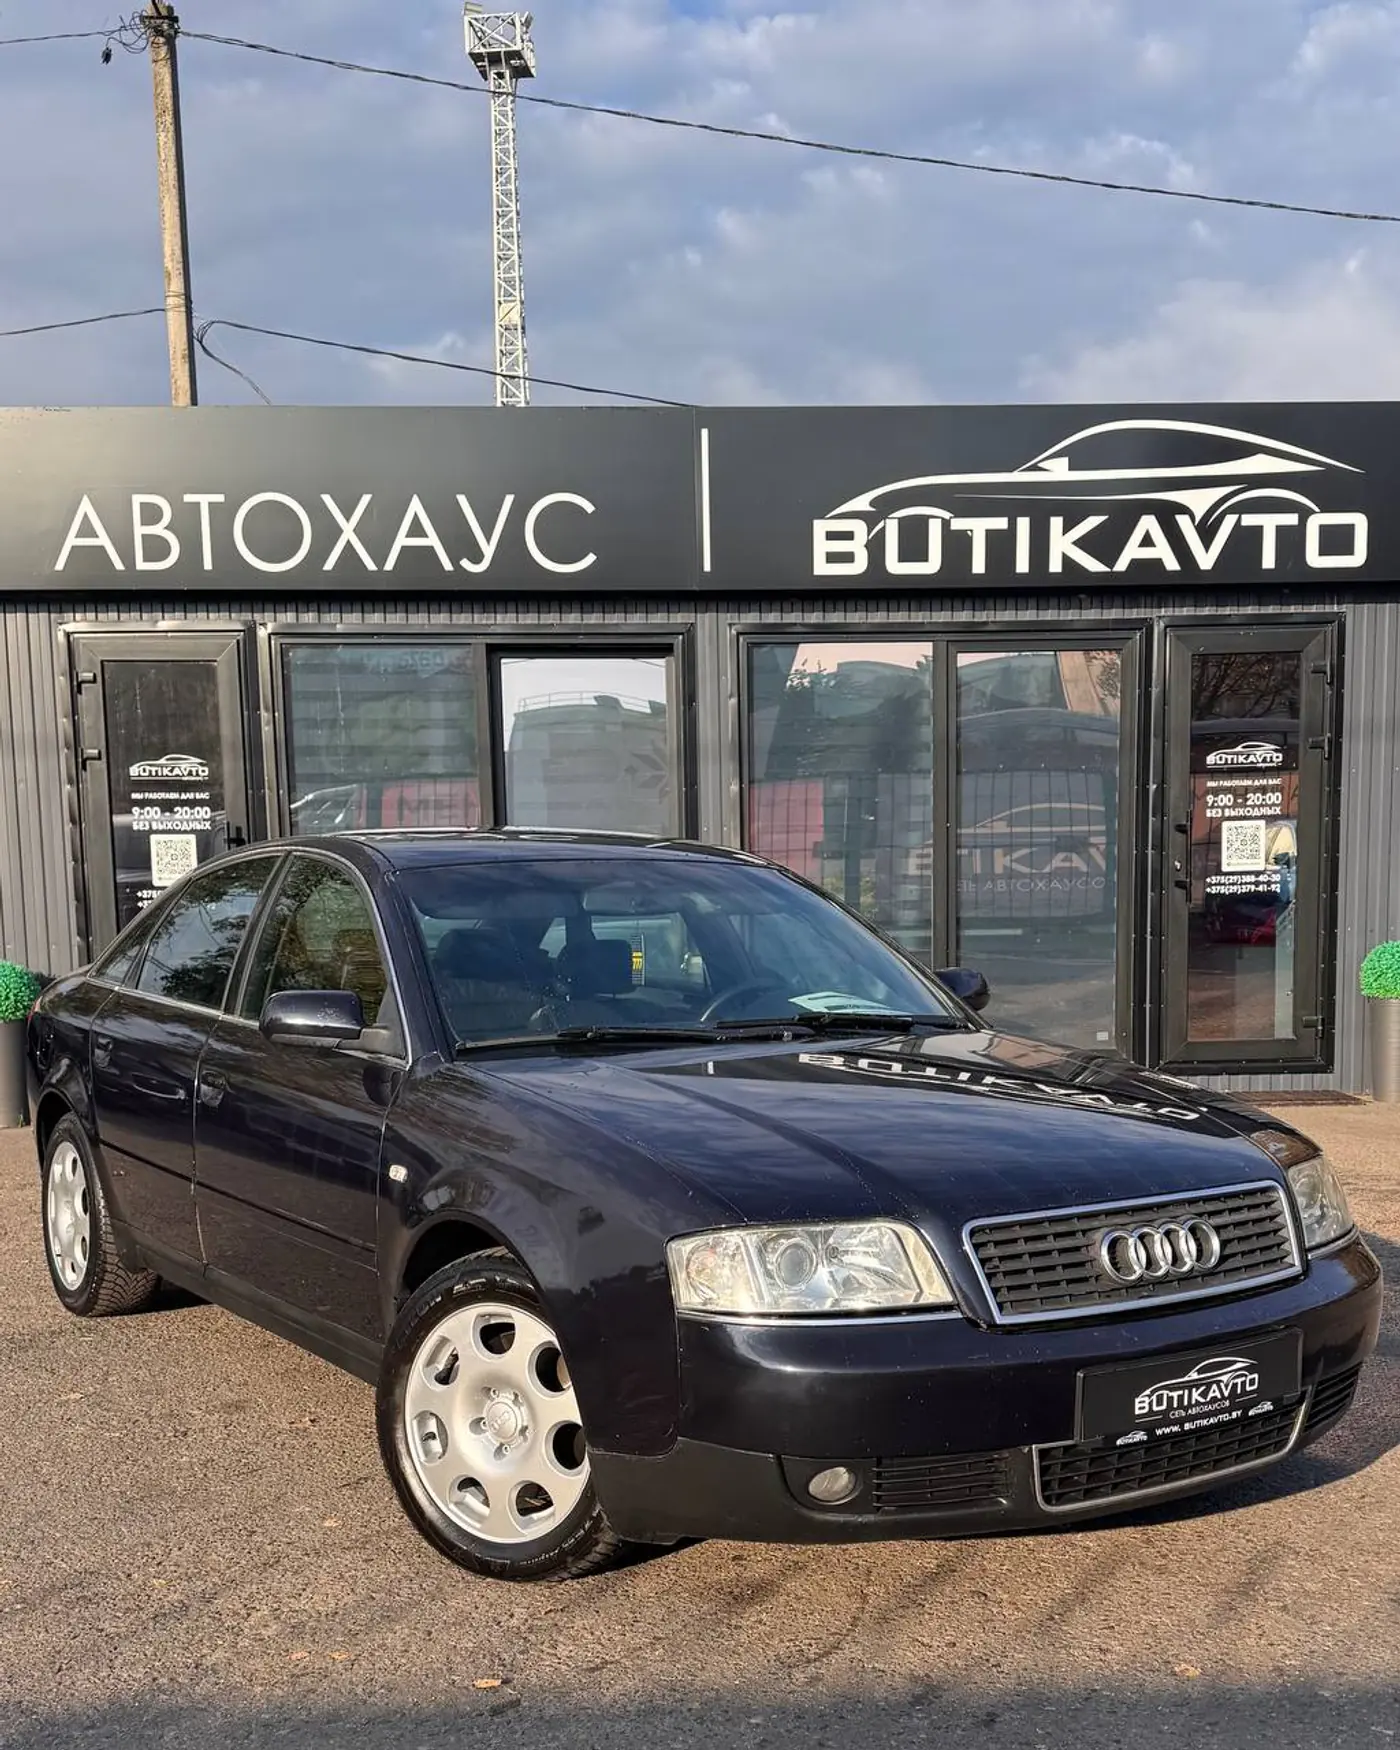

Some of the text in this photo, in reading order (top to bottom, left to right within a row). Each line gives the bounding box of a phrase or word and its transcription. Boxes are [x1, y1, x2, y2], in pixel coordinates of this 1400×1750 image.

[55, 492, 597, 574] АВТОХАУС
[813, 510, 1368, 577] BUTIKAVTO
[1206, 753, 1283, 764] BUTIKAVTO
[129, 766, 209, 776] BUTIKAVTO
[1268, 778, 1282, 786] ВАС
[195, 792, 210, 800] ВАС
[1206, 795, 1233, 807] 9:00
[1246, 792, 1282, 806] 20:00
[132, 806, 160, 819] 9:00
[174, 806, 211, 819] 20:00
[1206, 806, 1281, 818] БЕЗ ВЫХОДНЫХ
[132, 821, 211, 831] БЕЗ ВЫХОДНЫХ
[1134, 1373, 1259, 1416] BUTIKAVTO
[1169, 1400, 1231, 1419] СЕТЬ АВТОХАУСОВ
